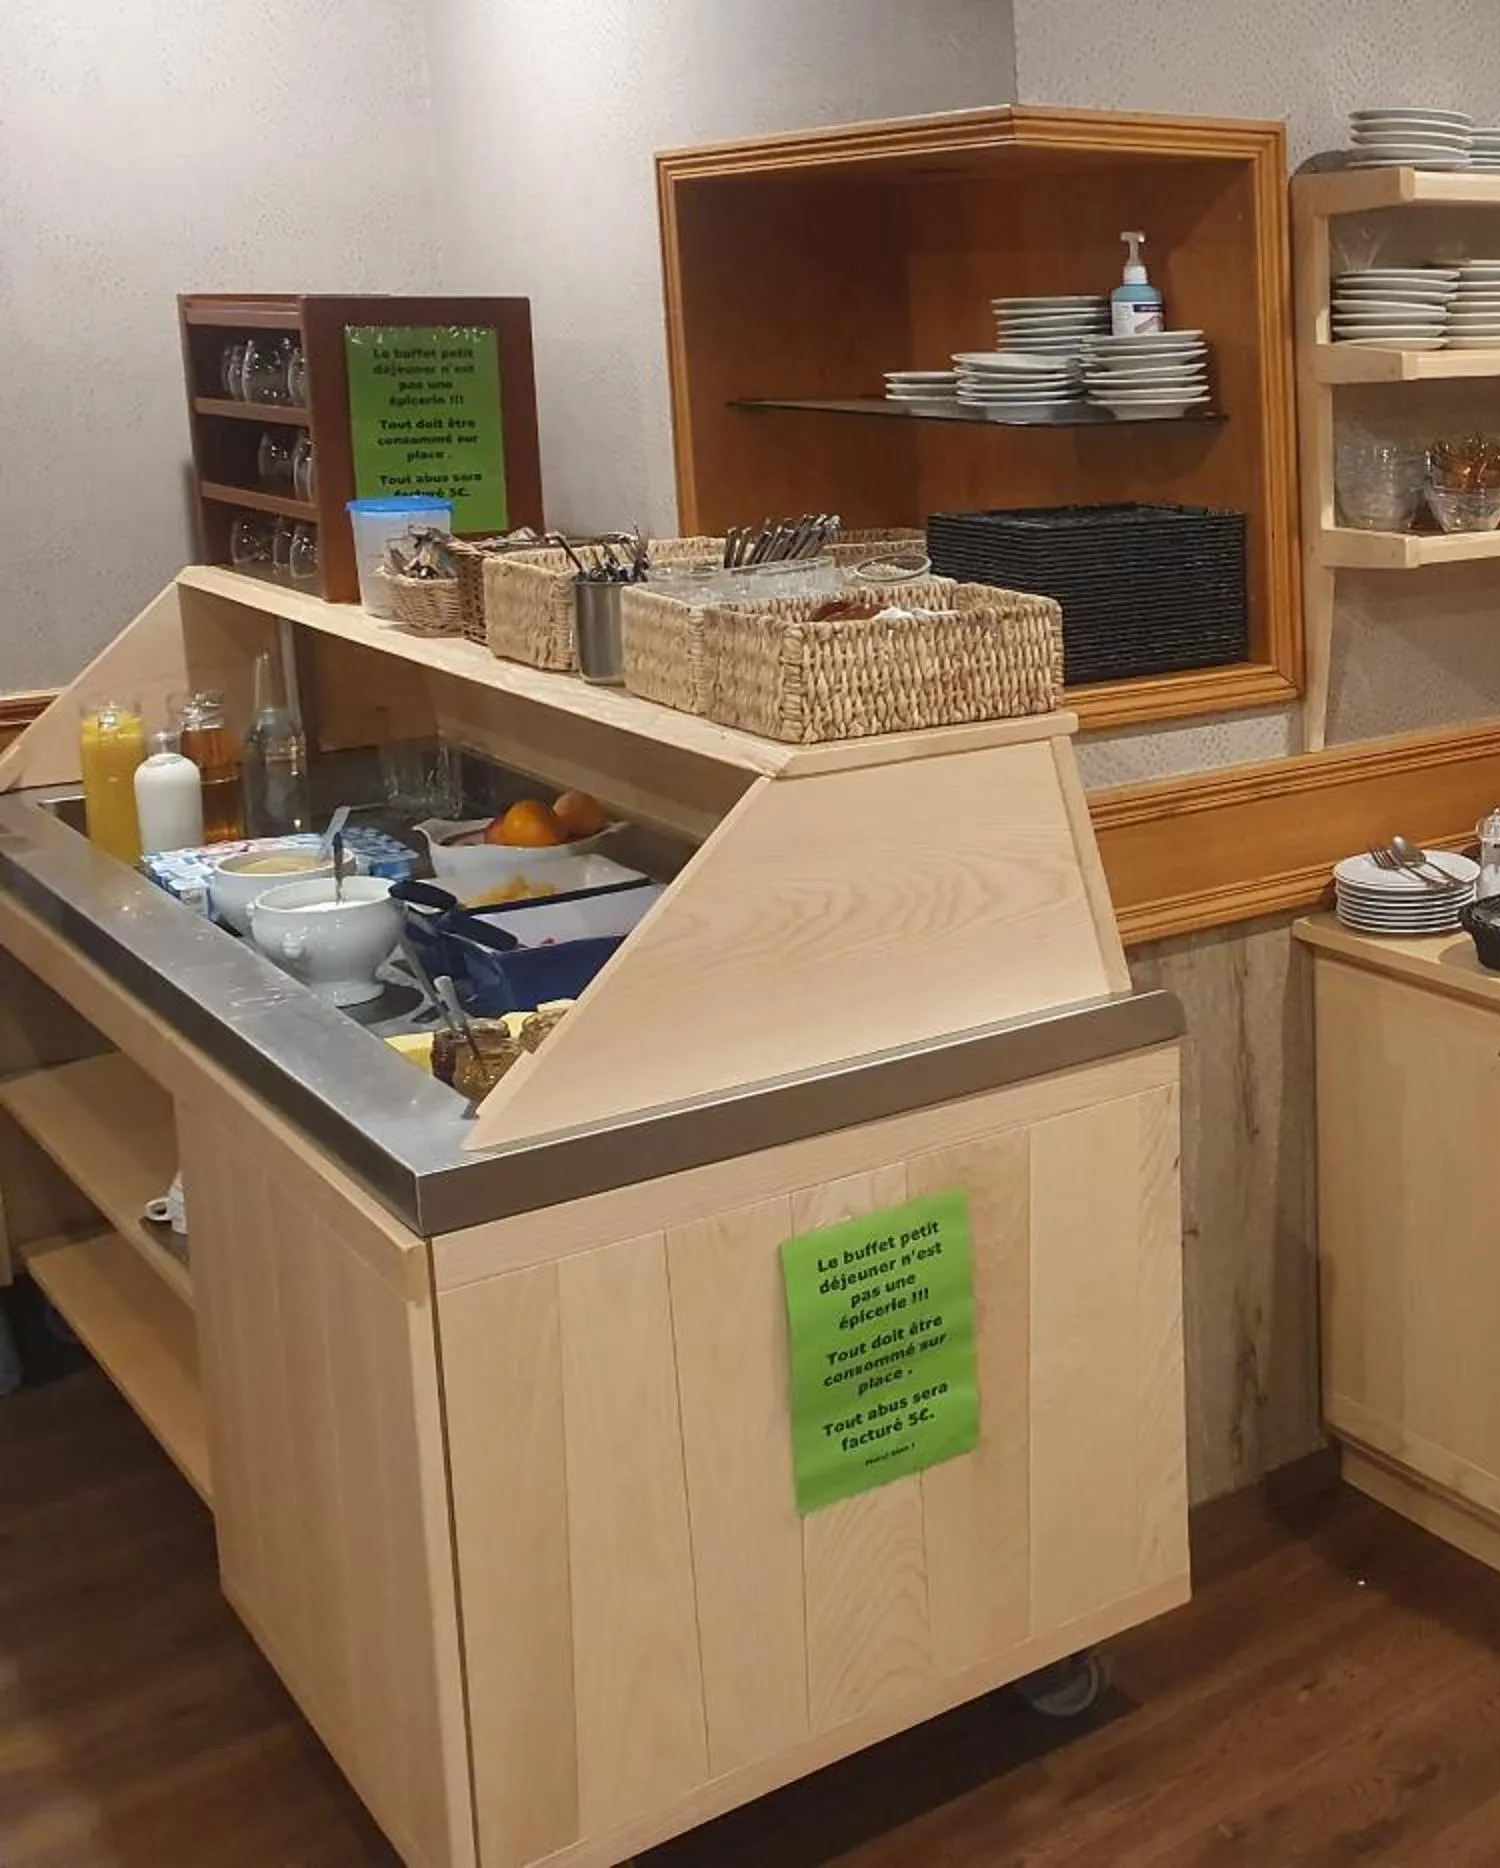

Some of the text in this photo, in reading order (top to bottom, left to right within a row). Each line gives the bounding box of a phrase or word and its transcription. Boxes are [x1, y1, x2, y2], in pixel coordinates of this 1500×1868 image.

[817, 1221, 939, 1273] Le buffet petit
[819, 1259, 897, 1294] déjeuner
[851, 1273, 916, 1308] pas une
[839, 1287, 929, 1330] épicerie !!!
[824, 1333, 946, 1387] consommé sur
[827, 1315, 942, 1366] Tout doit être
[858, 1369, 903, 1396] place
[823, 1383, 948, 1437] Tout abus sera
[842, 1418, 903, 1452] facturé
